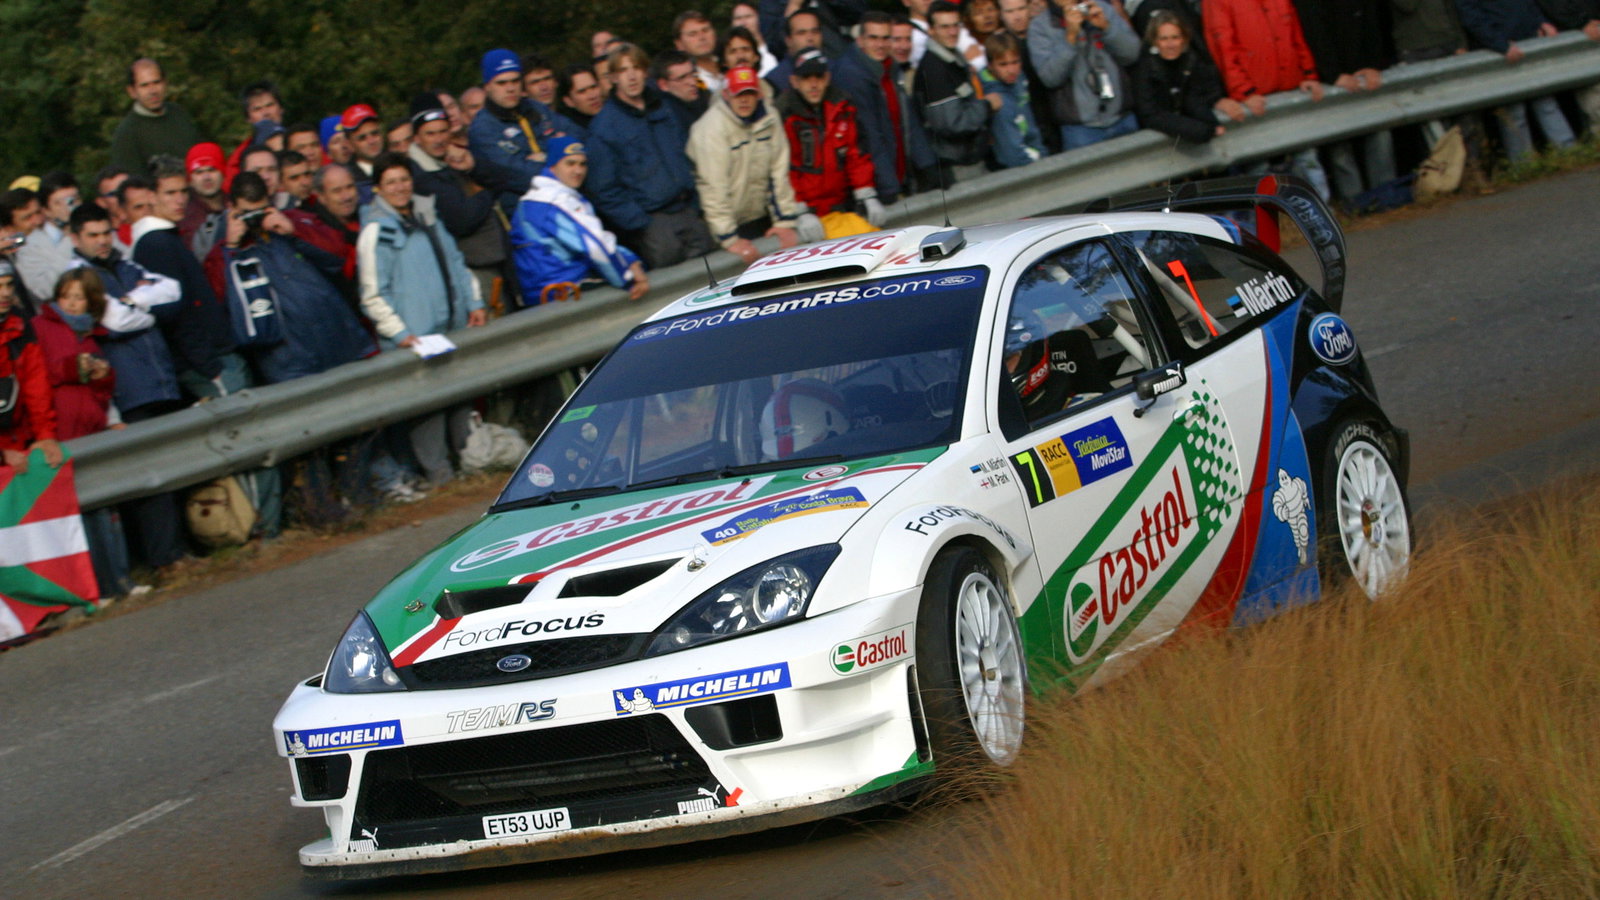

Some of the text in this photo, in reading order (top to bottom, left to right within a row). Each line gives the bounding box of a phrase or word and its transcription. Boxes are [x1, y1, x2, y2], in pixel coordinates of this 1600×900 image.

[664, 276, 932, 336] FordTeamRS.com
[1167, 259, 1218, 337] 7
[1235, 271, 1297, 319] Märtin
[1318, 319, 1354, 359] Ford
[1153, 377, 1181, 396] PUMA
[1041, 442, 1067, 463] RACC
[1091, 446, 1126, 471] MoviStar
[996, 472, 1010, 485] Park
[1015, 451, 1043, 504] 7
[526, 478, 755, 550] Castrol
[714, 527, 738, 539] 40
[1099, 465, 1192, 626] Castrol
[442, 612, 606, 651] FordFocus
[856, 629, 908, 668] Castrol
[656, 667, 783, 703] MICHELIN
[307, 725, 397, 749] MICHELIN
[487, 811, 565, 837] ET53 UJP
[677, 796, 716, 815] PUMA
